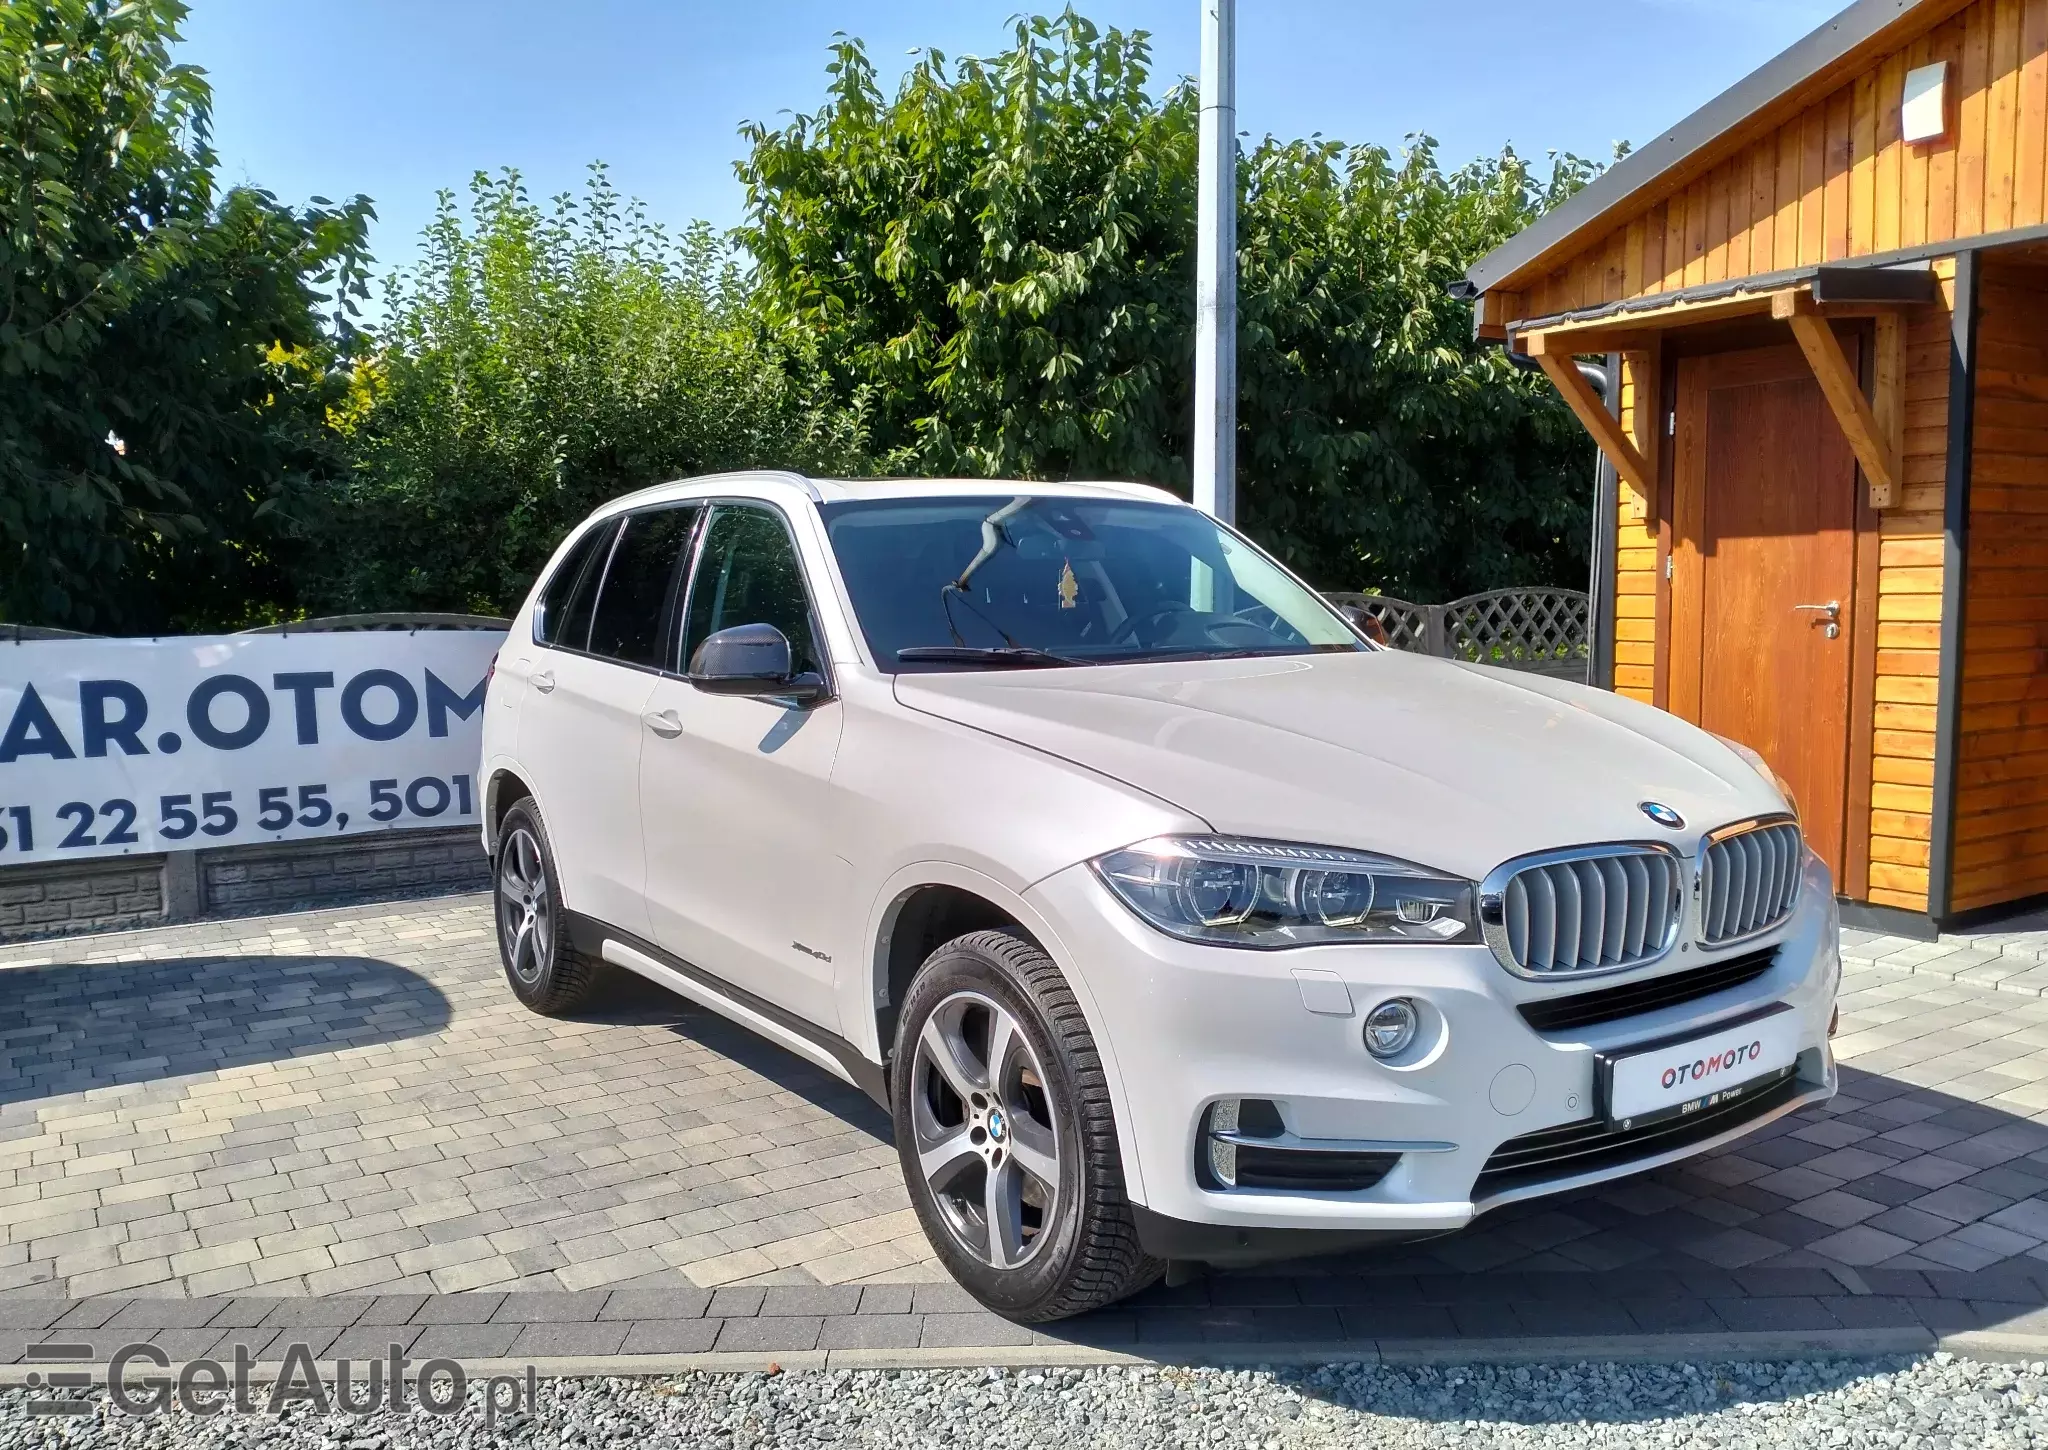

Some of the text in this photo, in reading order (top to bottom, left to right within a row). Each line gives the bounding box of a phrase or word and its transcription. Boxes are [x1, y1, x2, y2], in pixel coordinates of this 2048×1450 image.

[0, 774, 472, 852] 1 22 55 55, 501
[1661, 1041, 1760, 1089] OTOMOTO
[1682, 1099, 1702, 1114] BMW
[1722, 1087, 1743, 1101] Power
